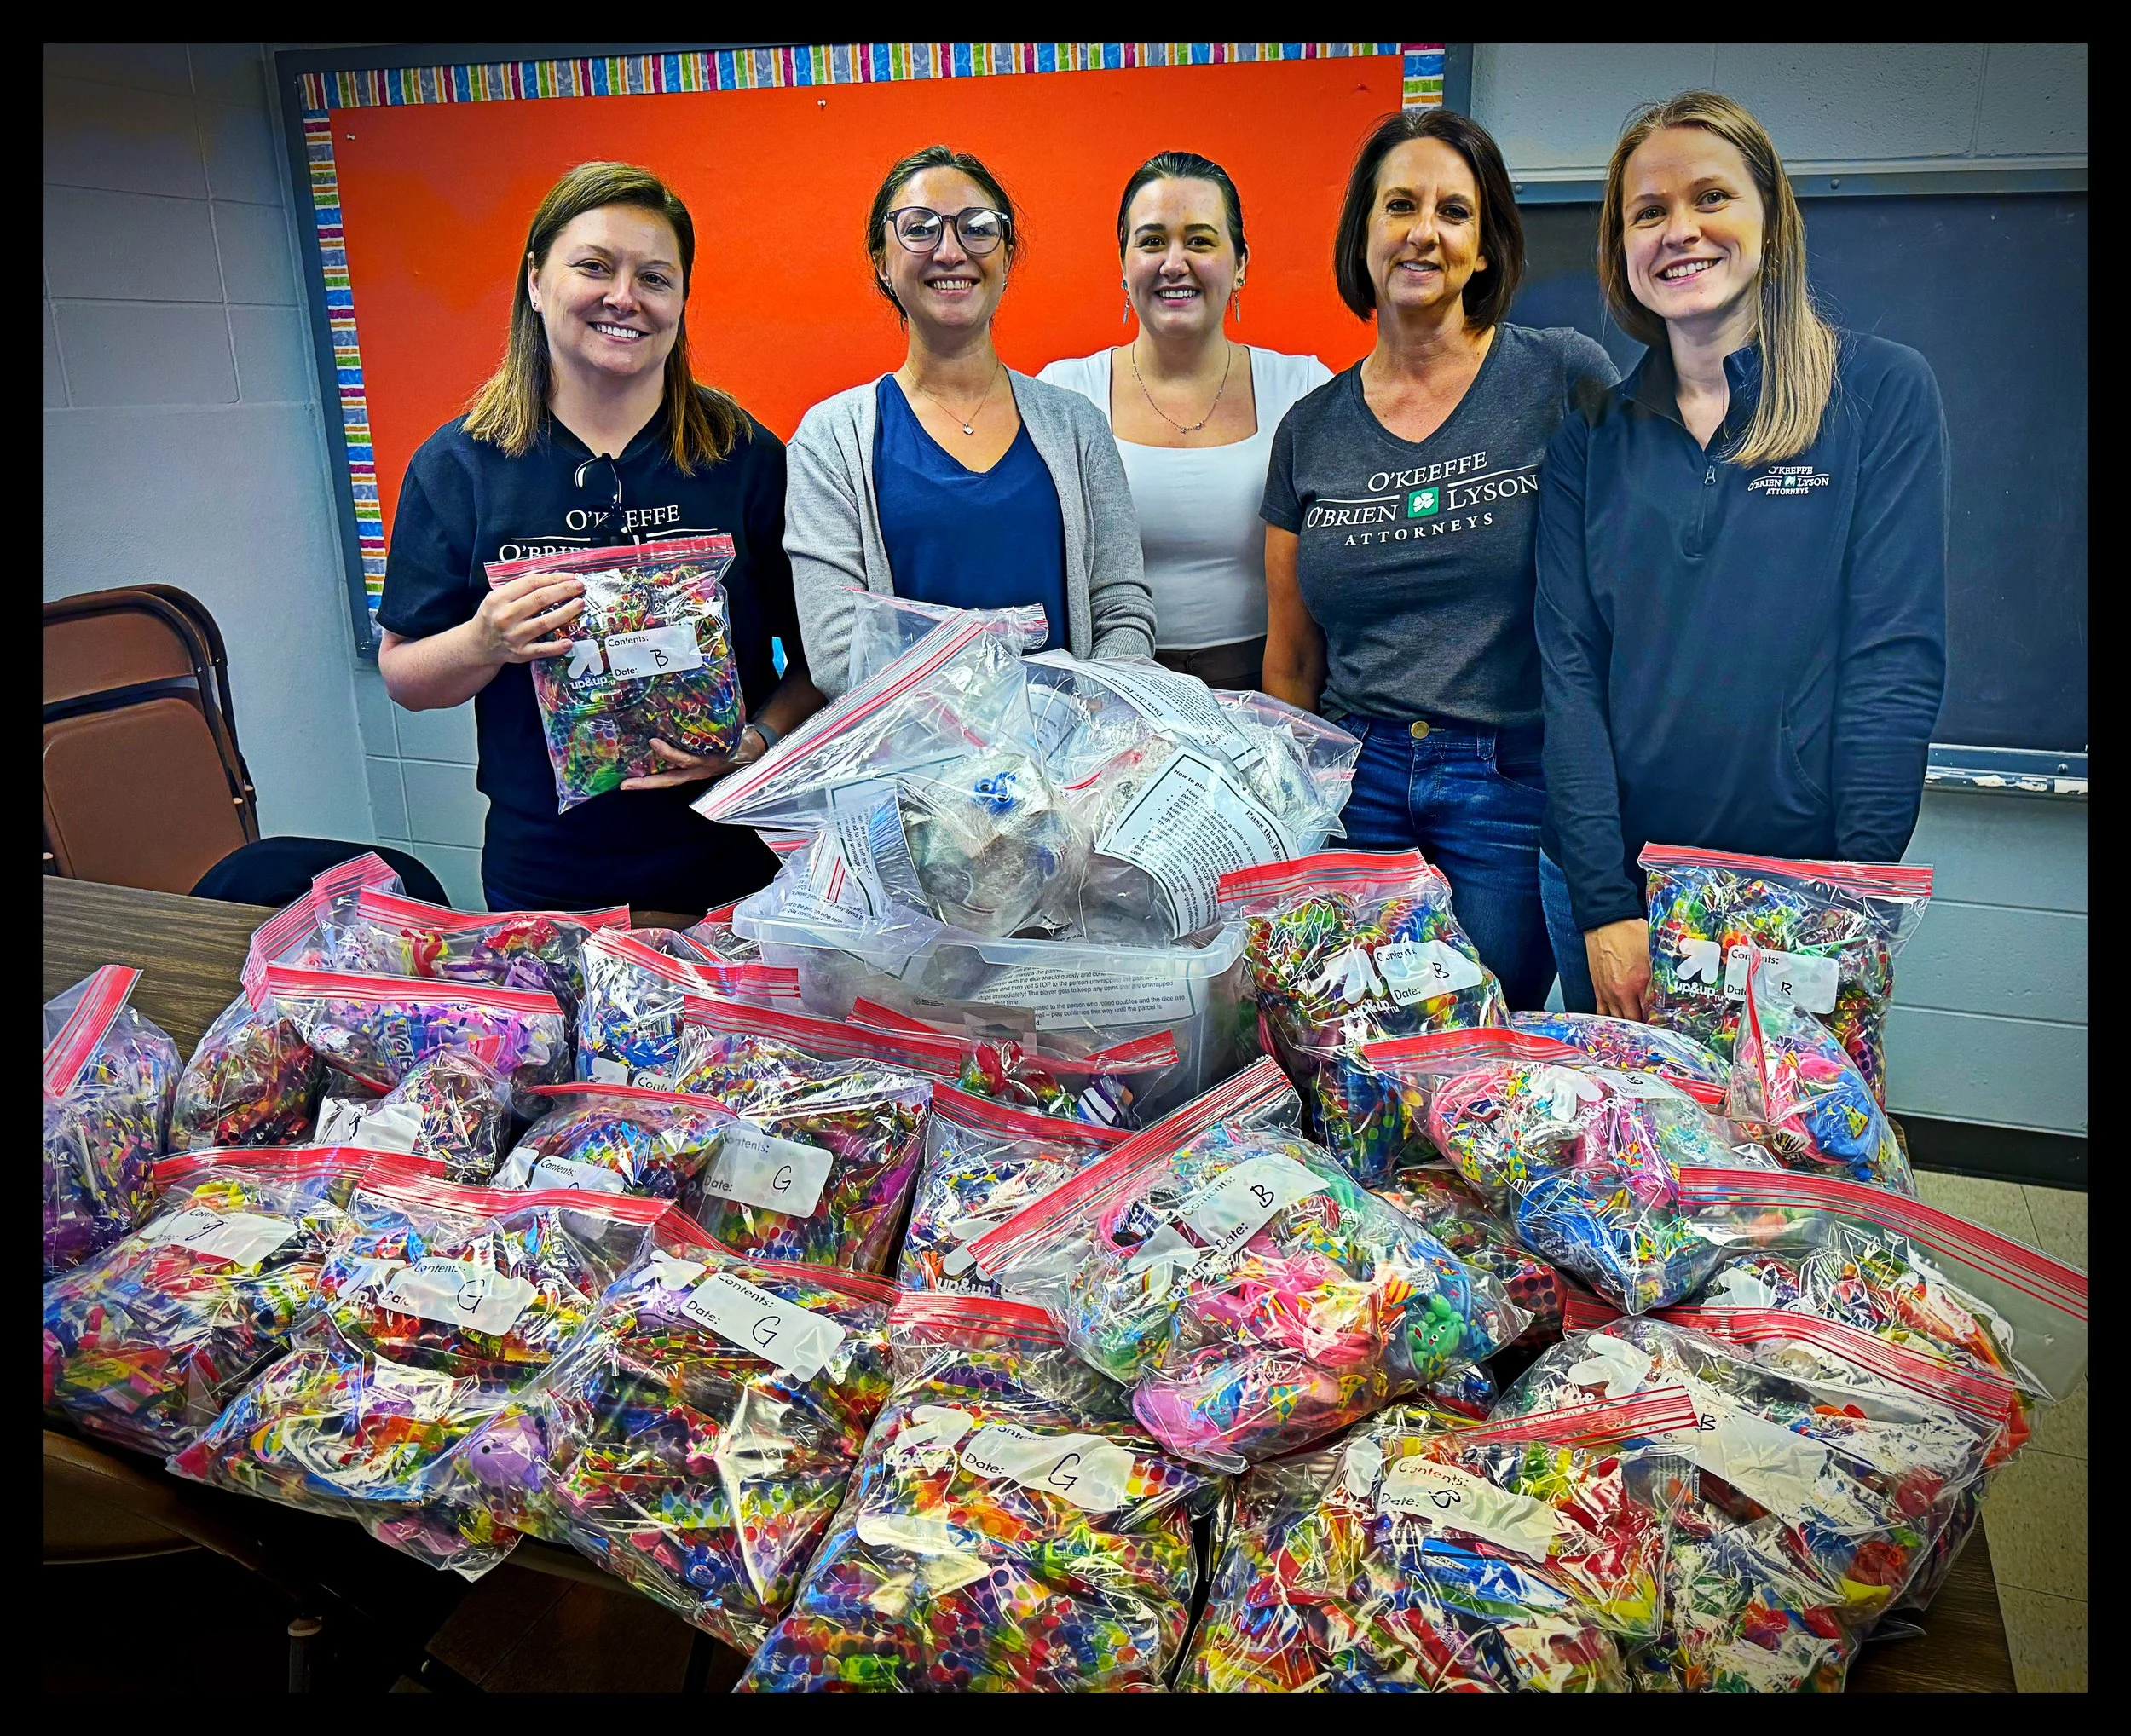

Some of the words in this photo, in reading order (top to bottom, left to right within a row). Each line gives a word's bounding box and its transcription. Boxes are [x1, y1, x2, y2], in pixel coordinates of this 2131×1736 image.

[1367, 451, 1487, 493] O'KEEFFE
[1768, 466, 1813, 475] O'KEEFFE
[1747, 479, 1782, 491] O'BRIEN
[1796, 477, 1830, 487] LYSON
[1766, 487, 1809, 495] ATTORNEYS
[1307, 504, 1400, 528] O'BRIEN
[1447, 474, 1539, 511] LYSON
[1344, 512, 1493, 547] ATTORNEYS
[607, 635, 650, 647] Contents:
[650, 649, 669, 669] B
[614, 666, 639, 677] Date:
[1174, 770, 1187, 779] How
[1177, 798, 1191, 807] Give
[1186, 788, 1200, 800] Have
[1173, 802, 1186, 811] Give
[1263, 828, 1274, 844] the
[1432, 962, 1450, 979] B
[1394, 989, 1421, 1001] Date:
[1781, 981, 1793, 996] R
[540, 1158, 577, 1177] Contents:
[704, 1174, 734, 1192] Date:
[772, 1165, 792, 1194] G
[1250, 1184, 1275, 1208] B
[1214, 1222, 1249, 1252] Date:
[718, 1273, 775, 1308] Contents:
[686, 1300, 722, 1325] Date:
[752, 1315, 782, 1348] G
[1699, 1413, 1716, 1431] B
[965, 1452, 1005, 1474] Date:
[1048, 1452, 1081, 1491] G
[1399, 1462, 1470, 1488] Contents:
[1381, 1492, 1420, 1508] Date:
